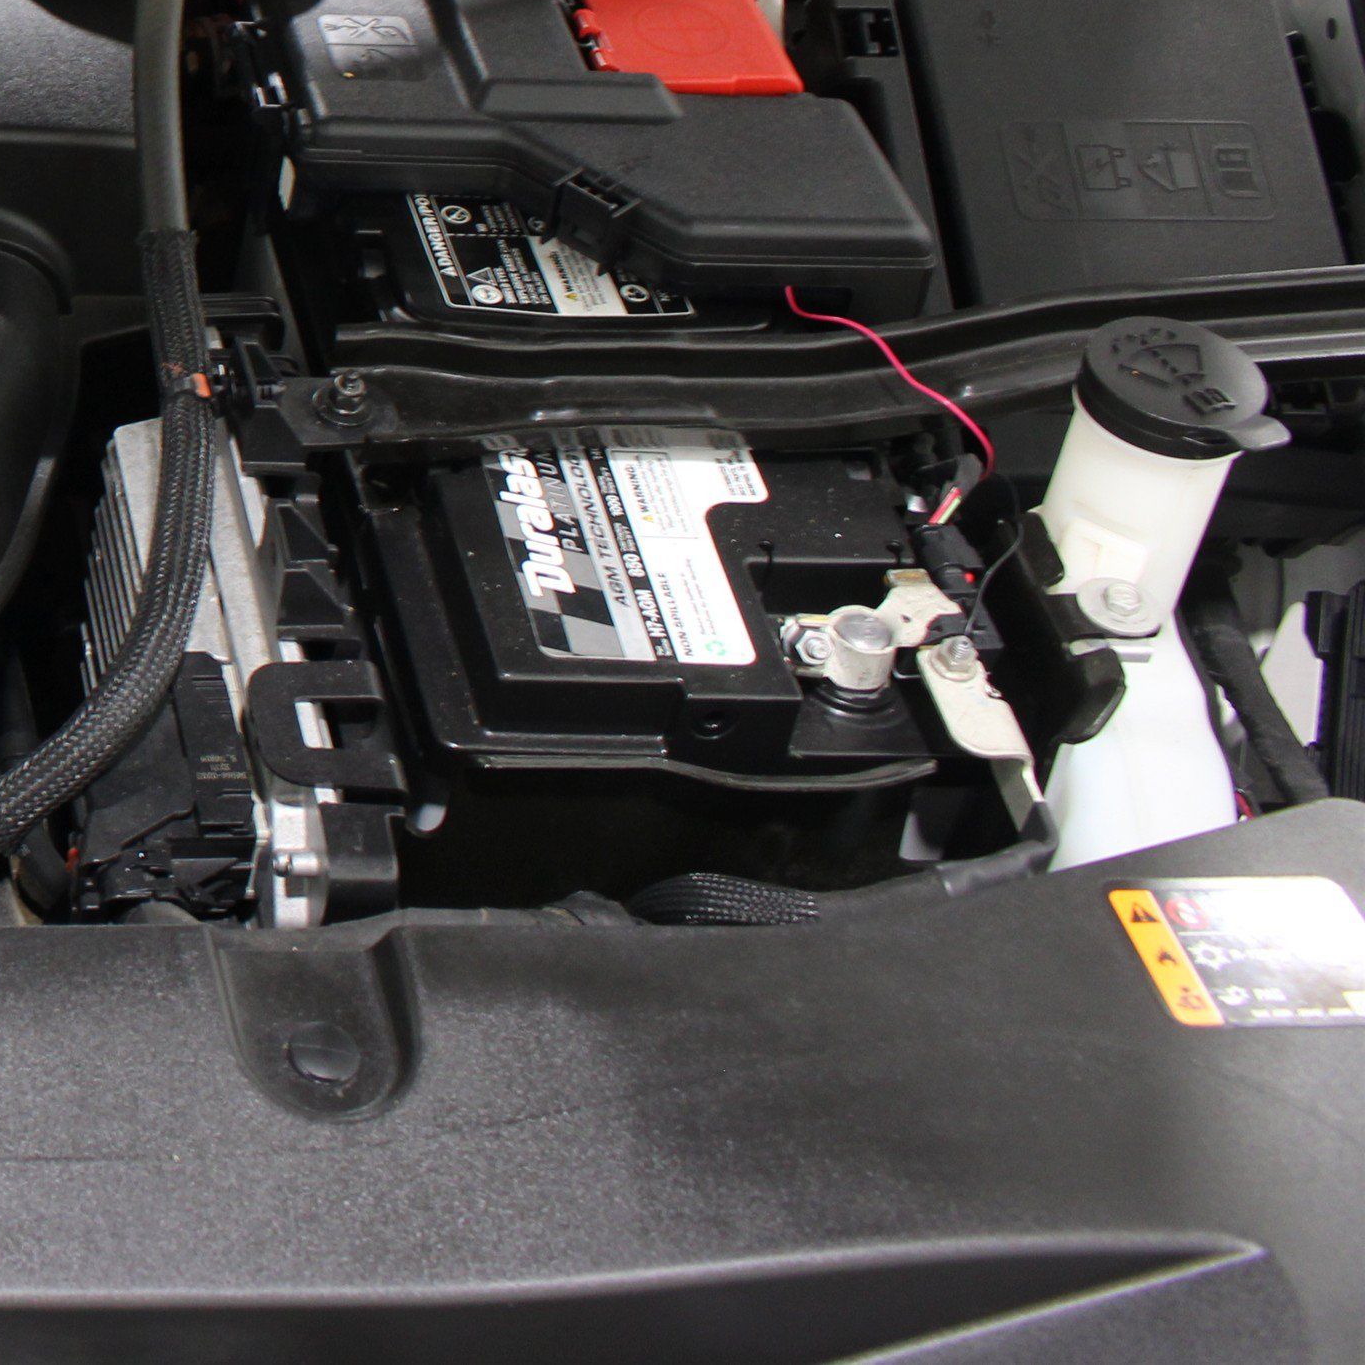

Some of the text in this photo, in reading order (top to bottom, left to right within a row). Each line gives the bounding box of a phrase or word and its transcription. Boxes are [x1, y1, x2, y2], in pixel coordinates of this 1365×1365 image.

[414, 194, 454, 267] DANGER/PO
[602, 564, 631, 608] AGM
[633, 589, 668, 638] H7-AGM
